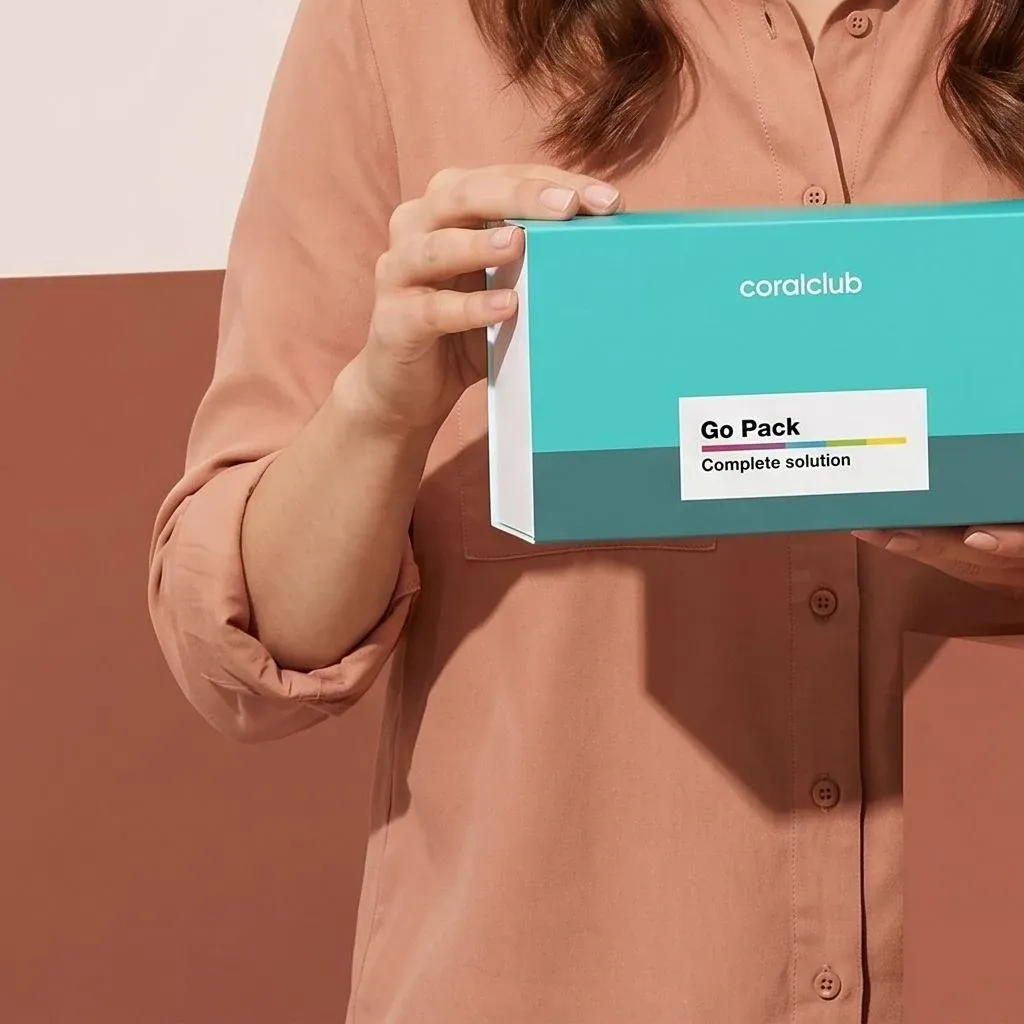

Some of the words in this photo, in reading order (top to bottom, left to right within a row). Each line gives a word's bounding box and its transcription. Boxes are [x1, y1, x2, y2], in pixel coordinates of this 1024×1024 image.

[739, 272, 863, 297] coralclub
[700, 420, 734, 439] Go
[741, 417, 801, 438] Pack
[701, 455, 781, 473] Complete
[785, 453, 851, 468] solution
